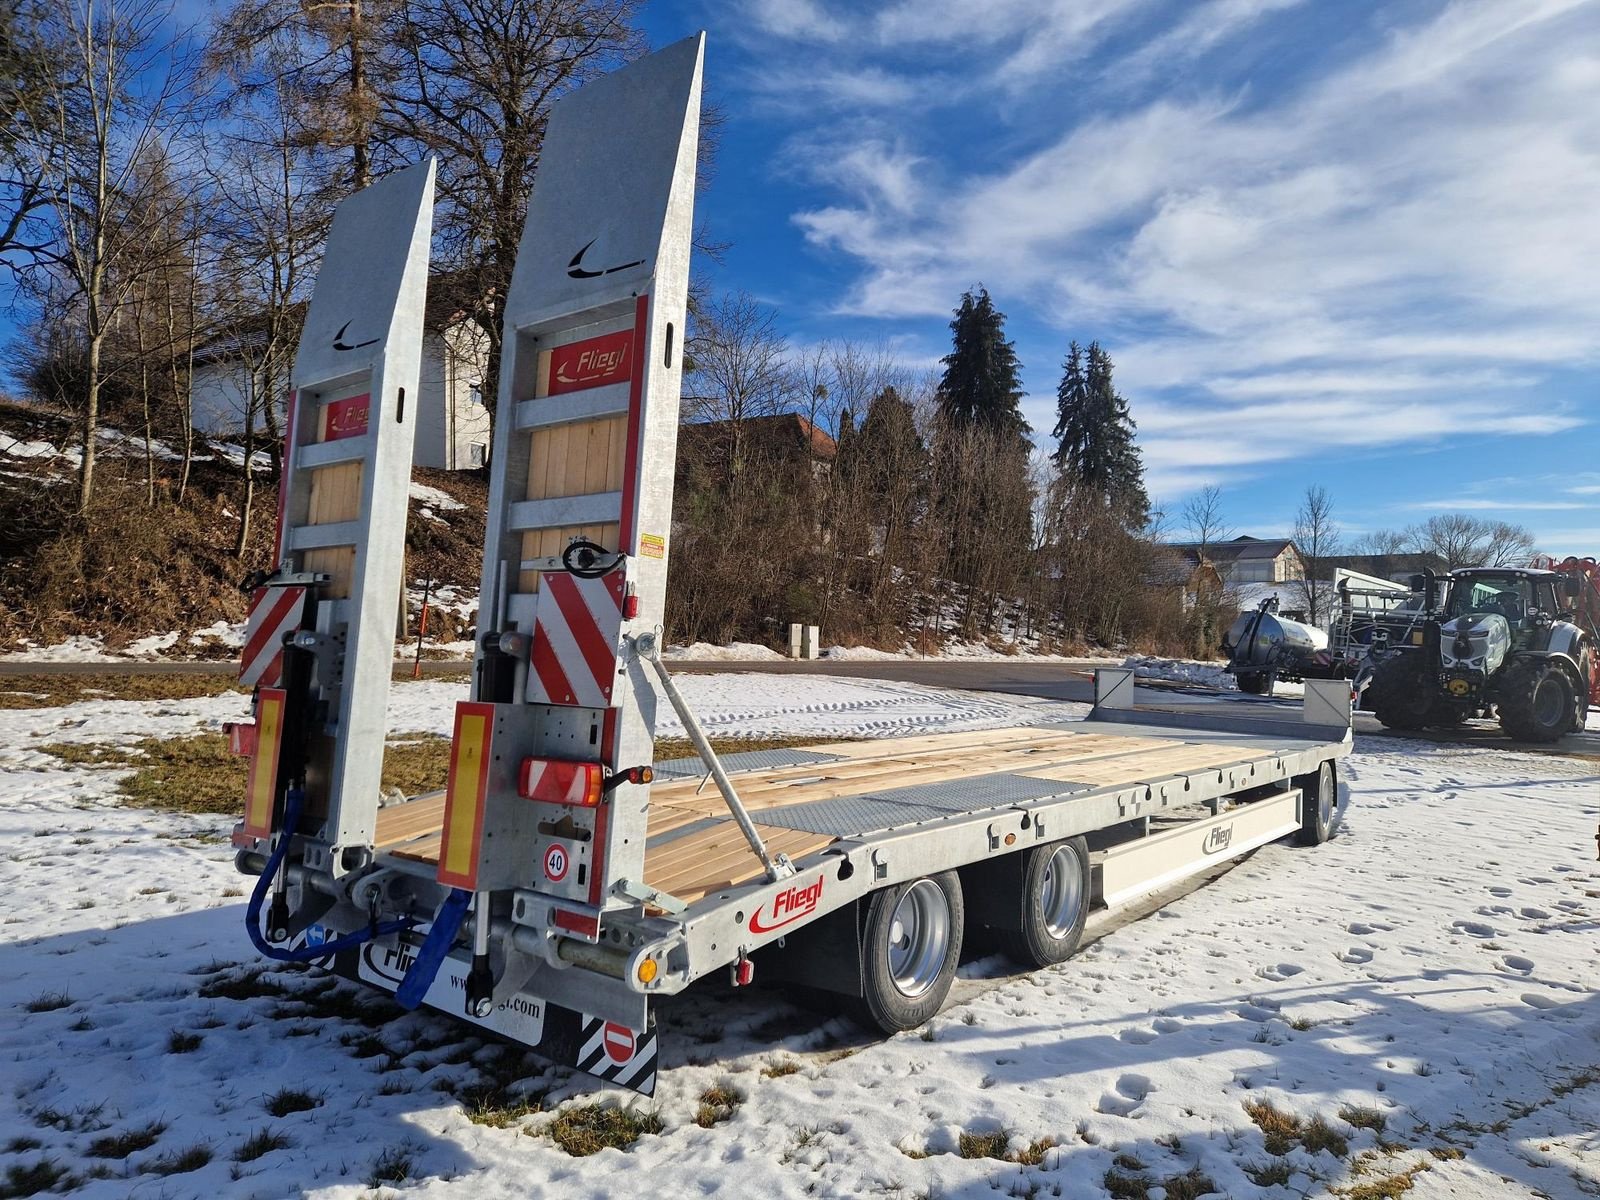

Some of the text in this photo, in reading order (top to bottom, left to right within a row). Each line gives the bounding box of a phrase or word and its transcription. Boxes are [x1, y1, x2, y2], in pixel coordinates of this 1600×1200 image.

[577, 342, 628, 372] Fliegl
[1210, 821, 1233, 847] Fliegl
[549, 853, 562, 871] 40
[773, 874, 824, 919] Fliegl
